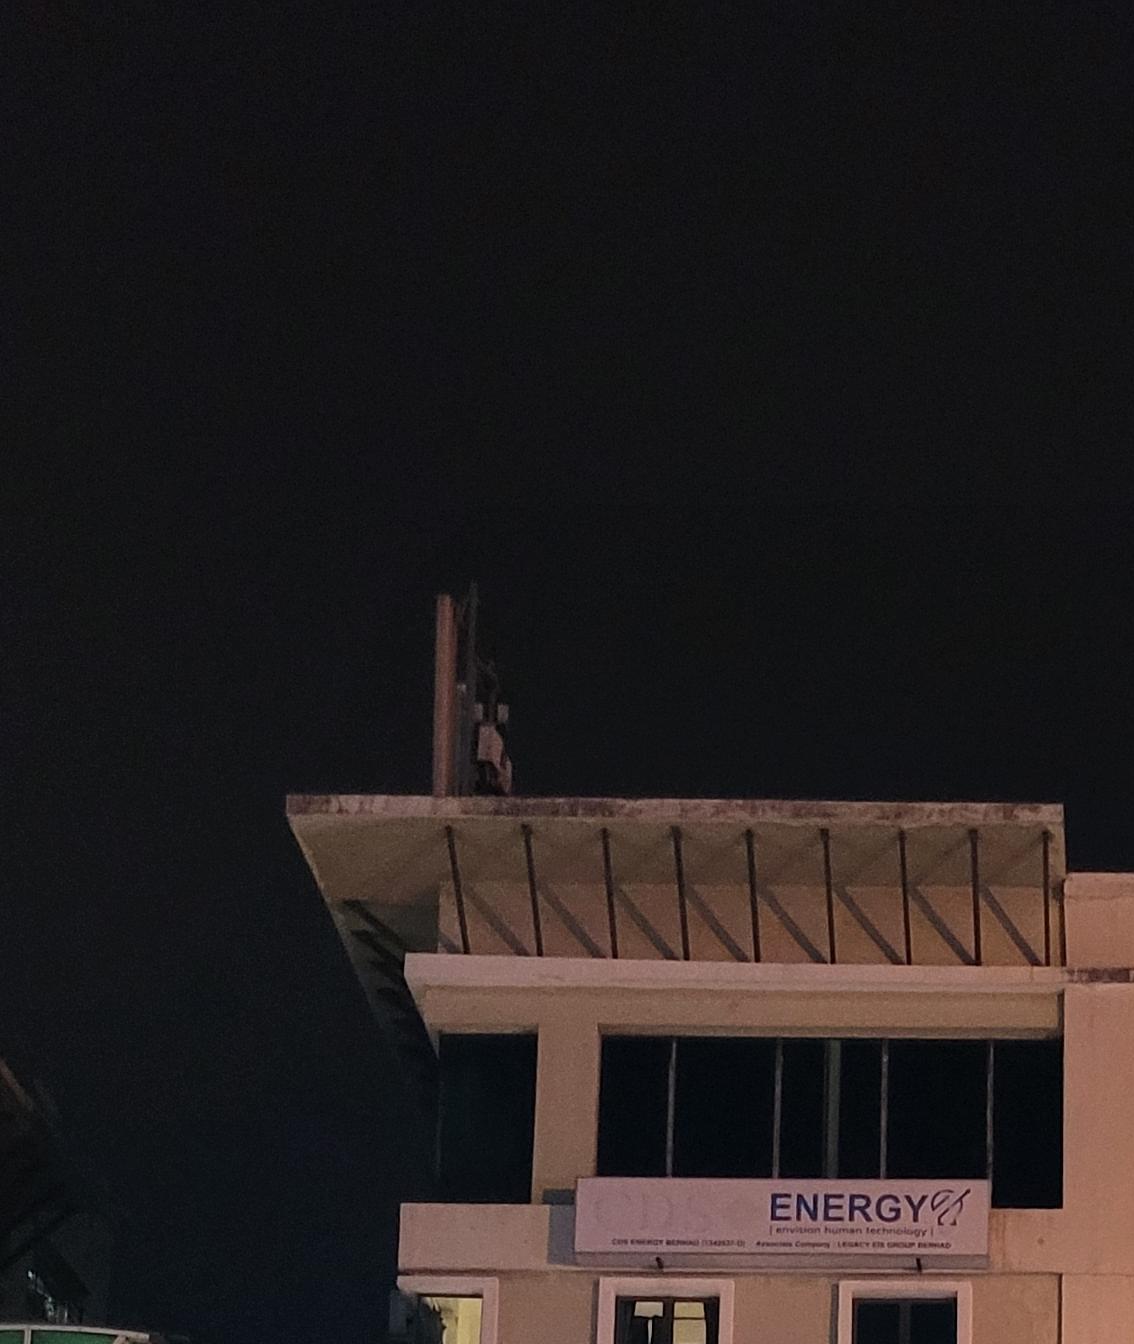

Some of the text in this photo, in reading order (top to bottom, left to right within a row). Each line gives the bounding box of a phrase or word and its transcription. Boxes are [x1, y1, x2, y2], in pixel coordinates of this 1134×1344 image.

[770, 1193, 929, 1223] ENERGY
[775, 1226, 928, 1238] envision human technology
